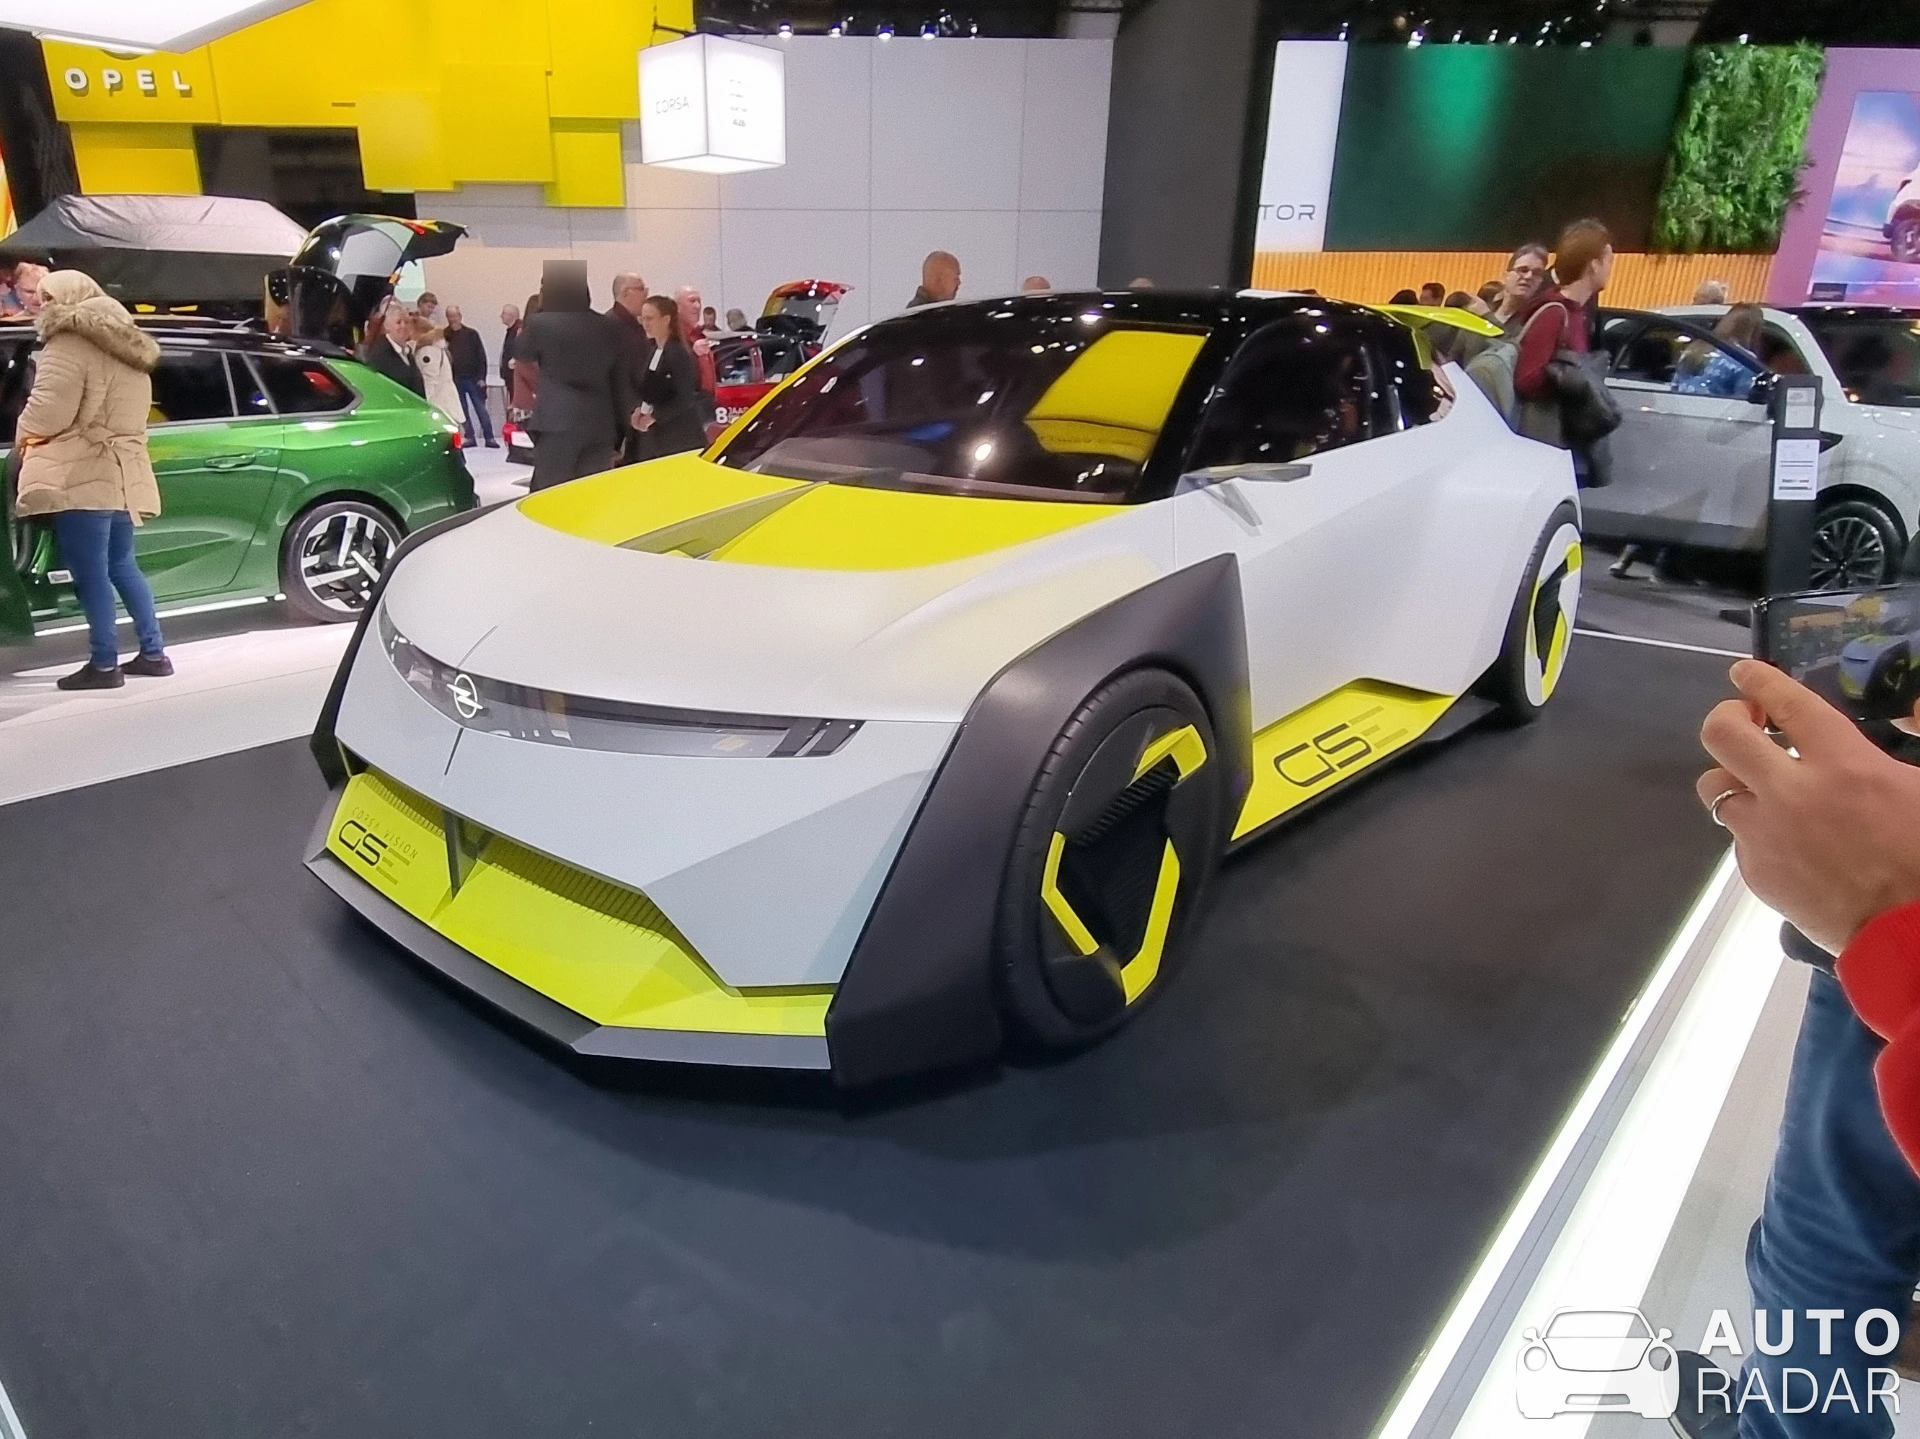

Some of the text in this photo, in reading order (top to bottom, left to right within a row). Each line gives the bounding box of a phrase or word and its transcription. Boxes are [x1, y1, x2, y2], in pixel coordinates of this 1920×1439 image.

[64, 67, 191, 91] OPEL
[655, 96, 690, 115] CORSA
[715, 406, 728, 424] 8
[1273, 705, 1409, 788] GSE
[338, 819, 411, 886] GSE
[383, 828, 419, 860] VISION
